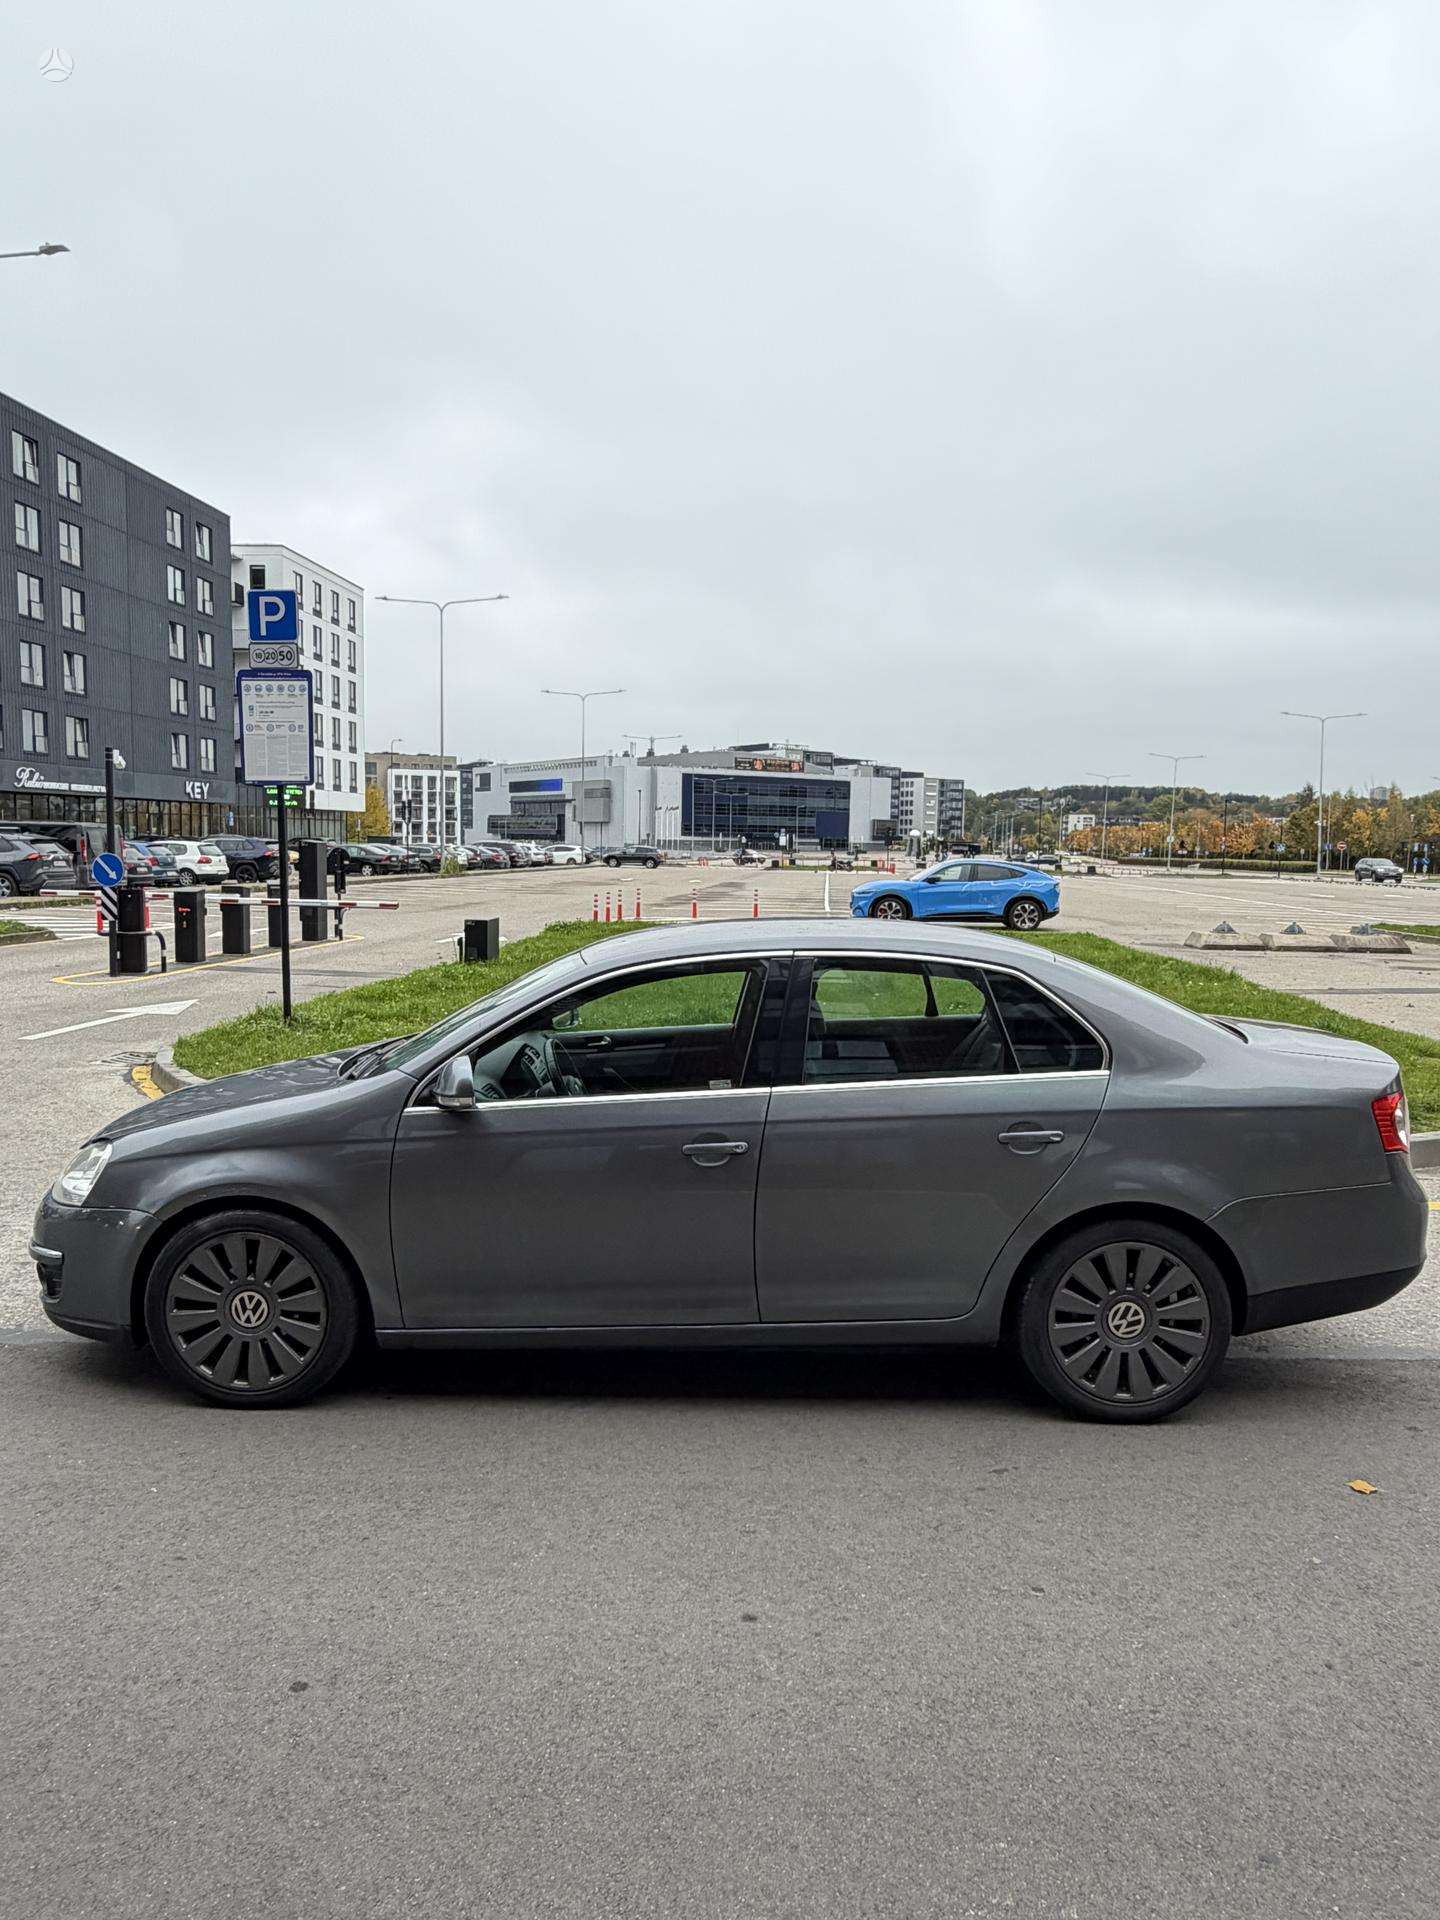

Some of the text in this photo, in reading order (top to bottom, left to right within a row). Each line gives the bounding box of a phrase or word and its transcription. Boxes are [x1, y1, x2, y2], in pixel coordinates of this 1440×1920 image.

[258, 596, 286, 636] P
[265, 652, 276, 661] 20
[279, 651, 293, 661] 50
[185, 781, 210, 800] KEY
